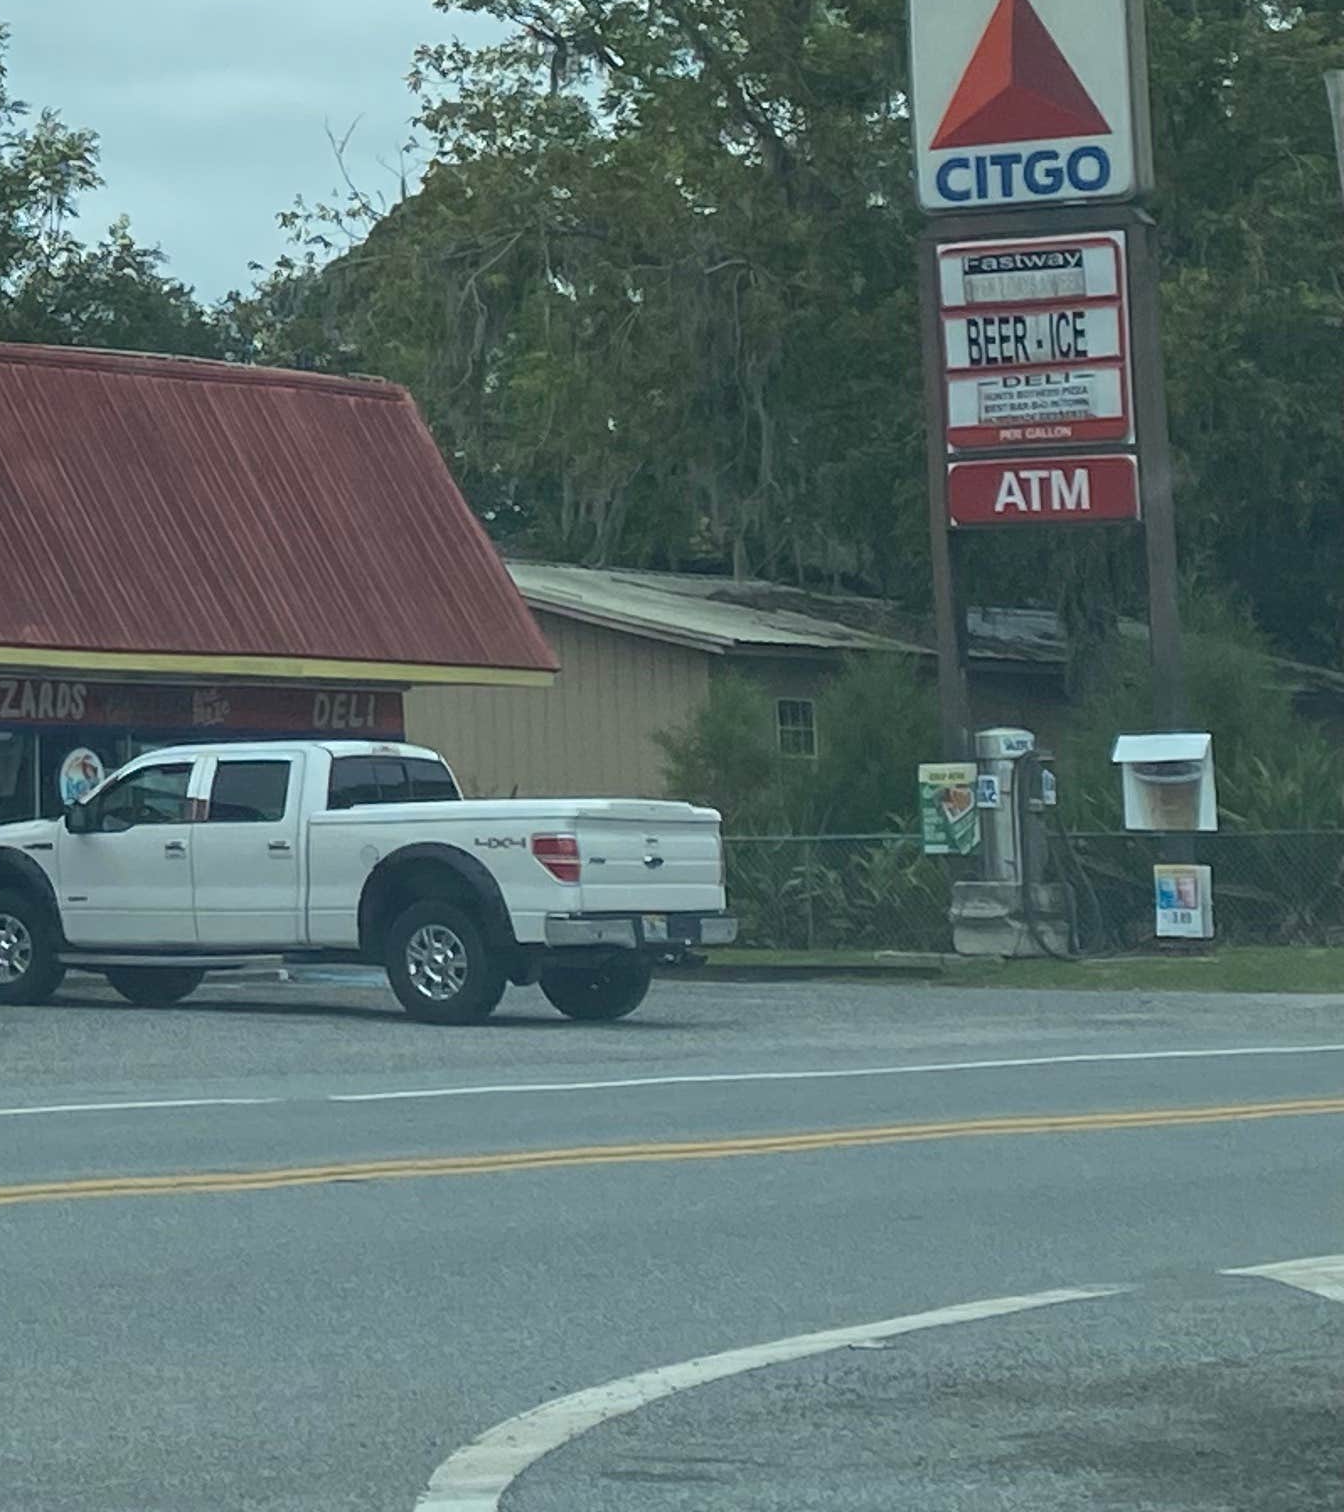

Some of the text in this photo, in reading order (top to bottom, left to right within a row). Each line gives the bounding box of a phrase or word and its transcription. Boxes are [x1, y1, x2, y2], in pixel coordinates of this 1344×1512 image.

[935, 145, 1111, 202] CITGO
[963, 251, 1082, 272] Fastway
[966, 311, 1088, 365] BEER ICE
[1002, 372, 1070, 388] DELI
[1000, 426, 1072, 440] PER GALLON
[994, 468, 1091, 512] ATM
[313, 692, 375, 729] DELI
